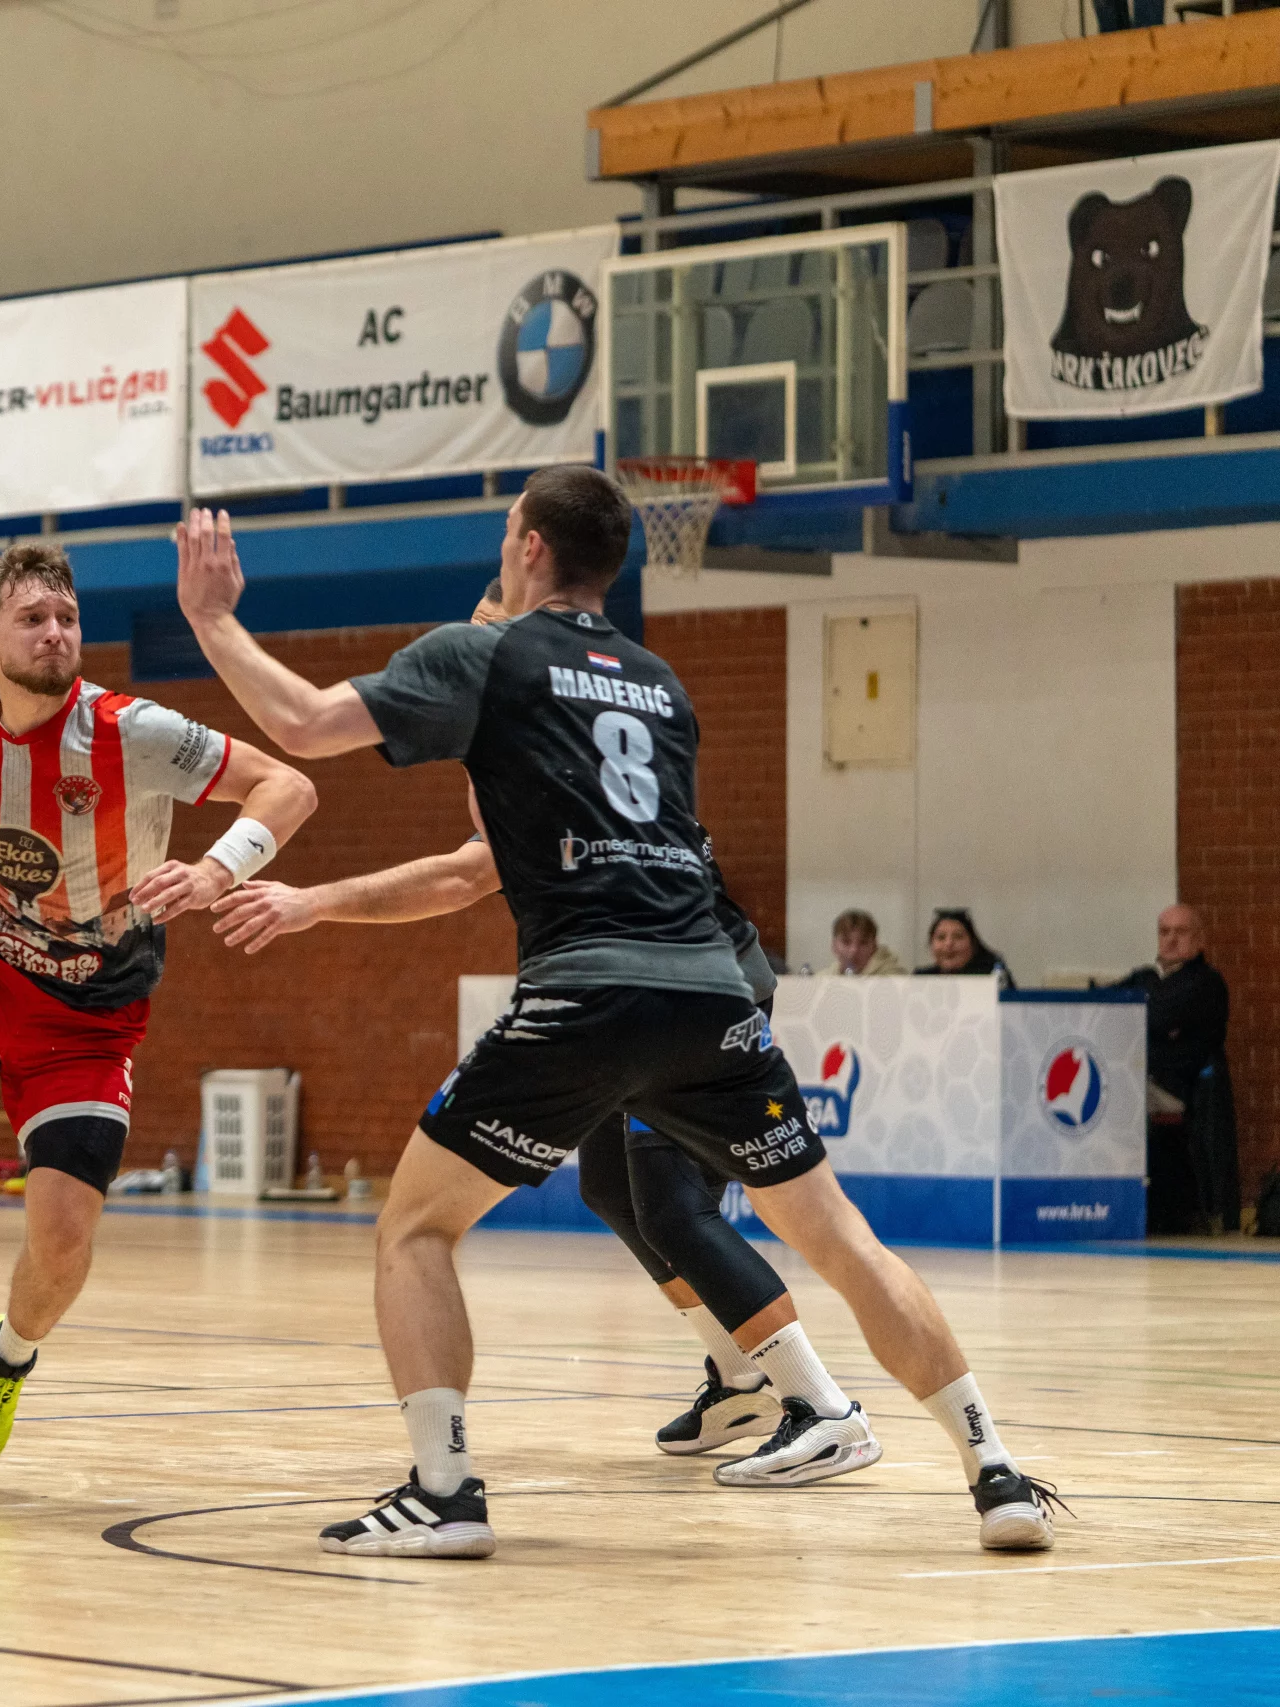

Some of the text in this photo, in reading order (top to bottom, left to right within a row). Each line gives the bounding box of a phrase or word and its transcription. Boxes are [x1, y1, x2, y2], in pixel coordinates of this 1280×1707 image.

[358, 306, 406, 347] AC
[275, 370, 489, 424] Baumgartner
[548, 666, 674, 718] MAĐERIĆ
[593, 710, 661, 823] 8
[730, 1117, 802, 1157] GALERIJA
[746, 1135, 808, 1171] SJEVER
[448, 1414, 466, 1453] Kempa
[963, 1403, 986, 1447] Kempa
